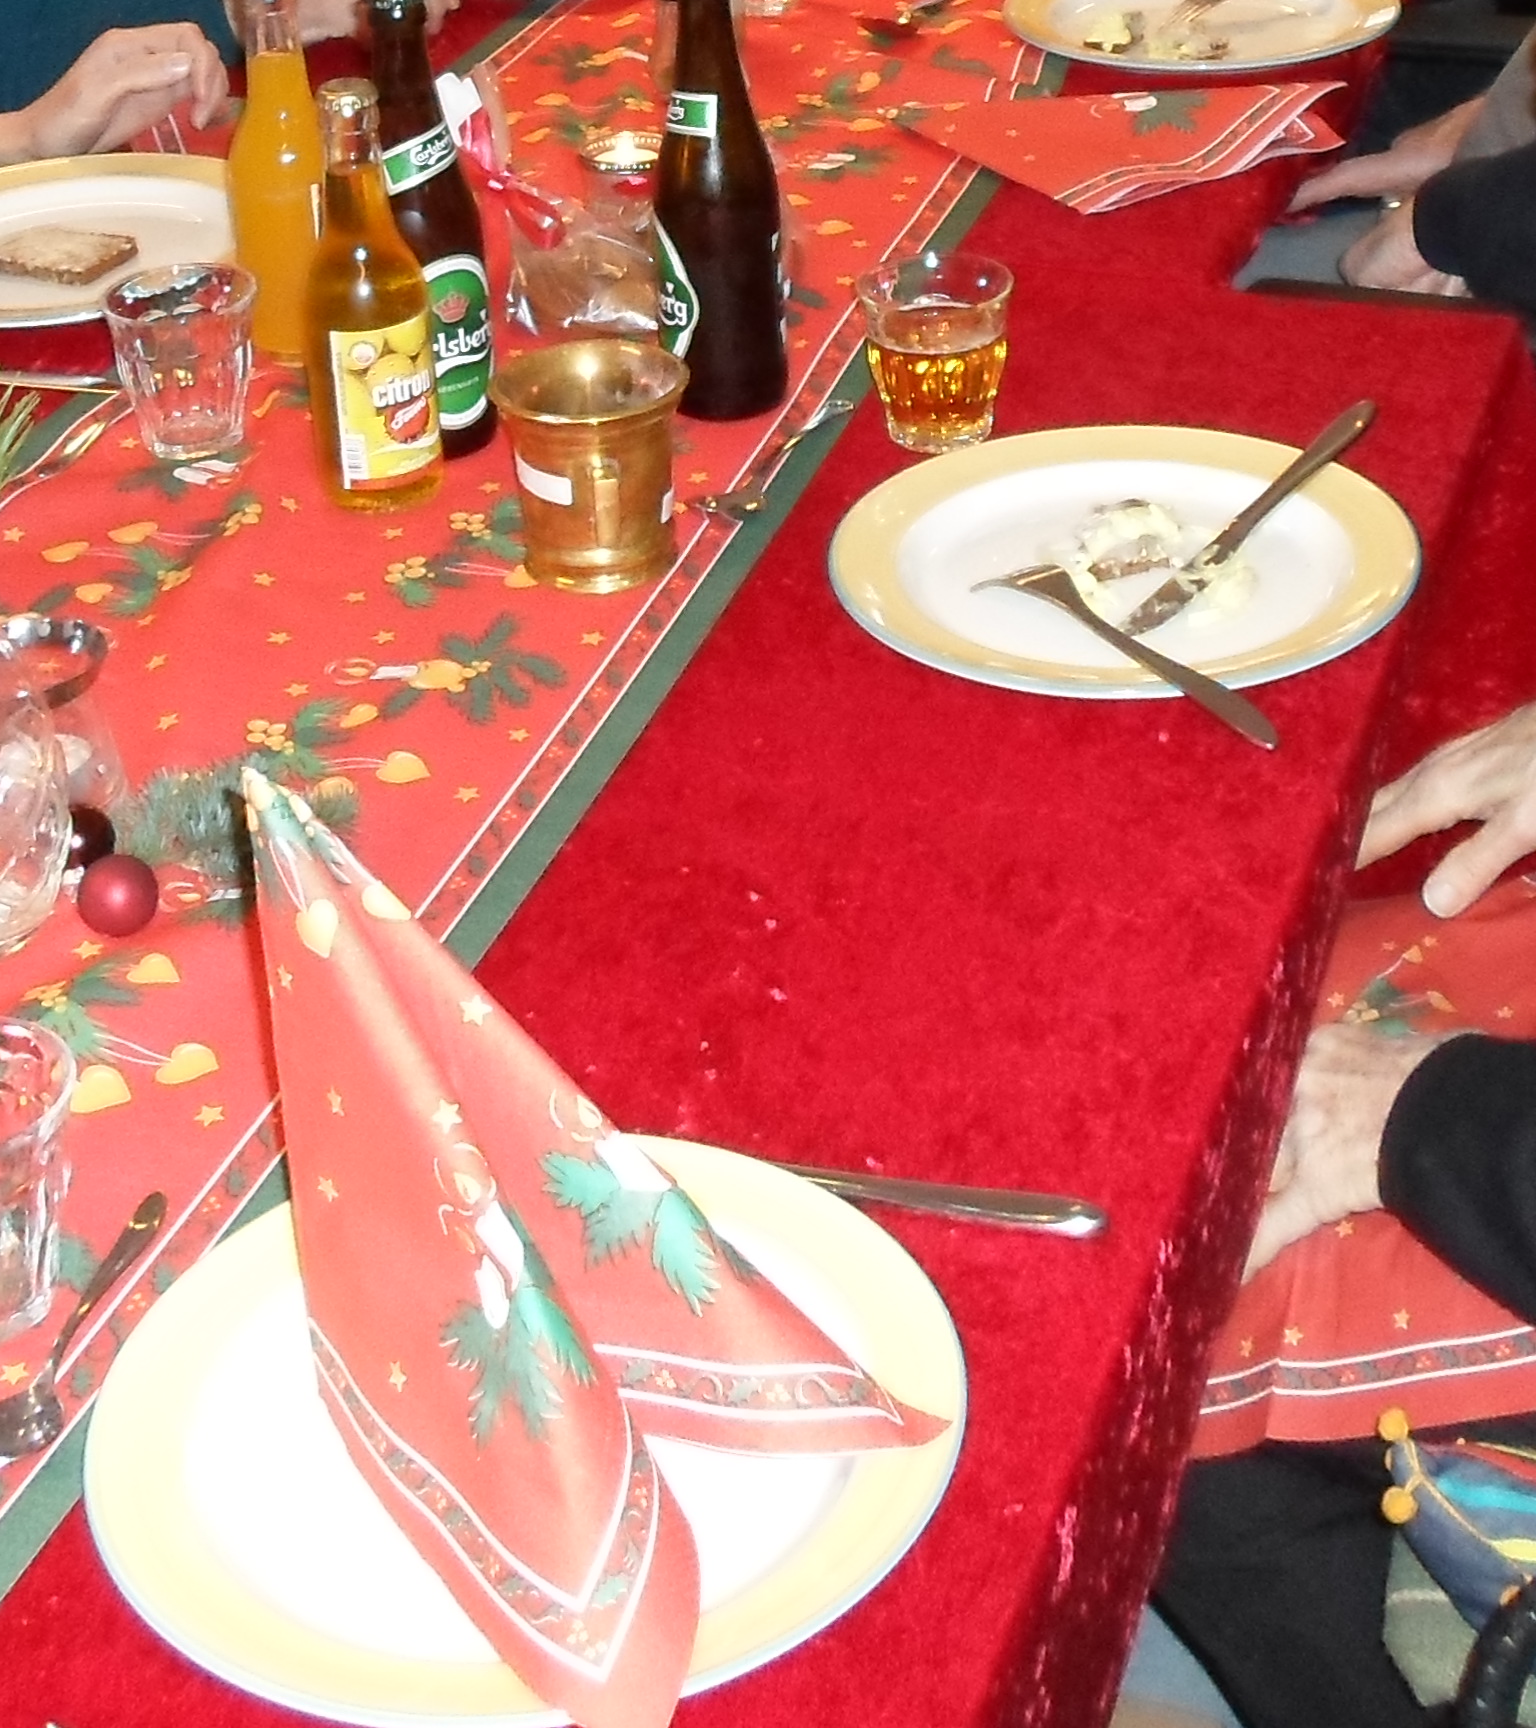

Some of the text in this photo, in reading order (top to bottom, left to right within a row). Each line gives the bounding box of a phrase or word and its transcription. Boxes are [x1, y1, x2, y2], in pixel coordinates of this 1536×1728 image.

[409, 134, 452, 166] Carlsber
[432, 321, 492, 360] lsber
[371, 368, 431, 408] citron
